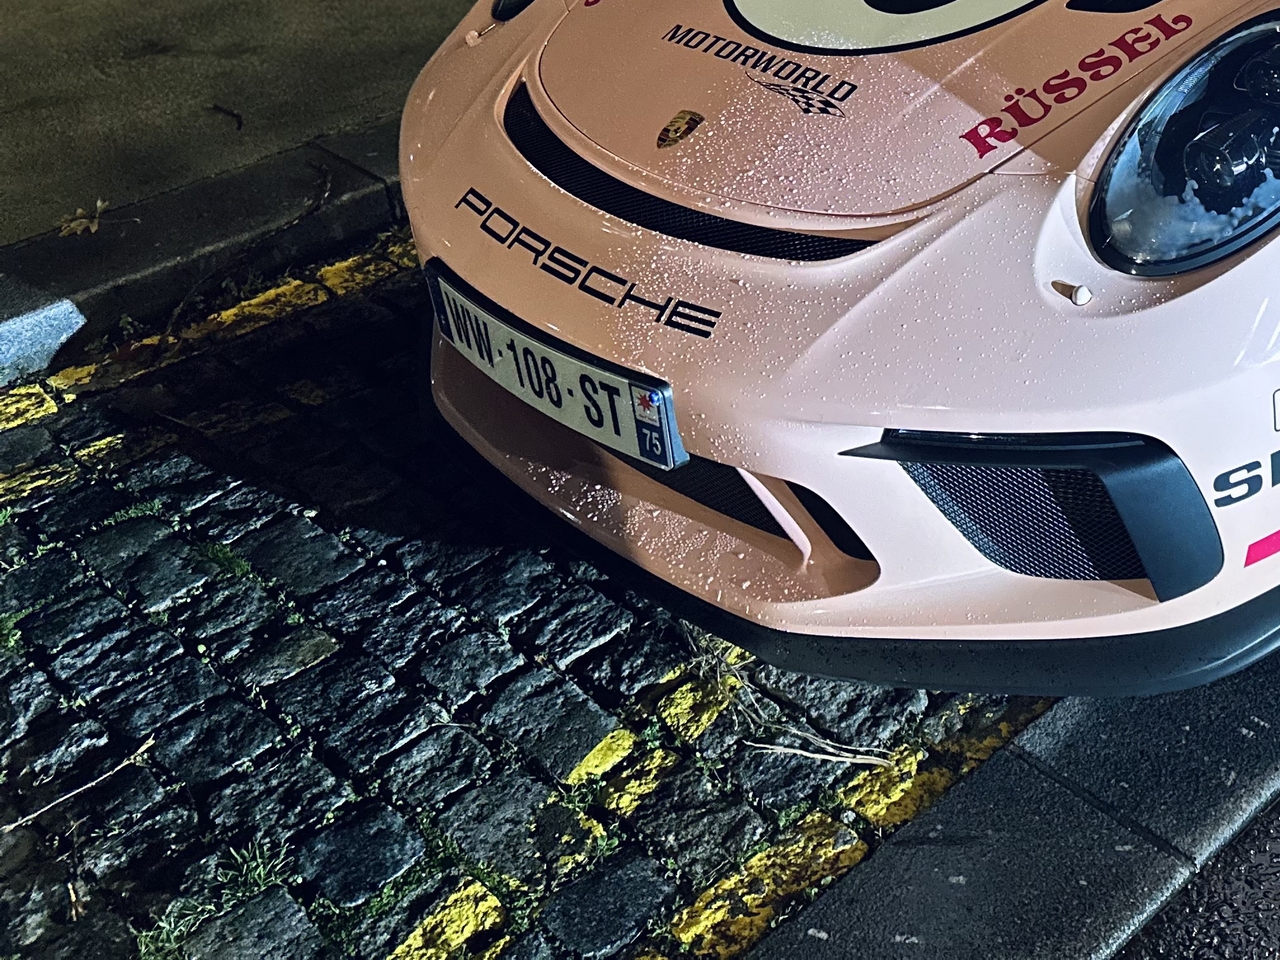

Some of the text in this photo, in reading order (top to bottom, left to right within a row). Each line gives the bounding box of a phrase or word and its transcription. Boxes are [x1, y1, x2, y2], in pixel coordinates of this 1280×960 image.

[661, 24, 858, 103] MOTORWORLD
[959, 13, 1193, 159] RÜSSEL
[455, 187, 722, 338] PORSCHE
[642, 427, 662, 456] 75
